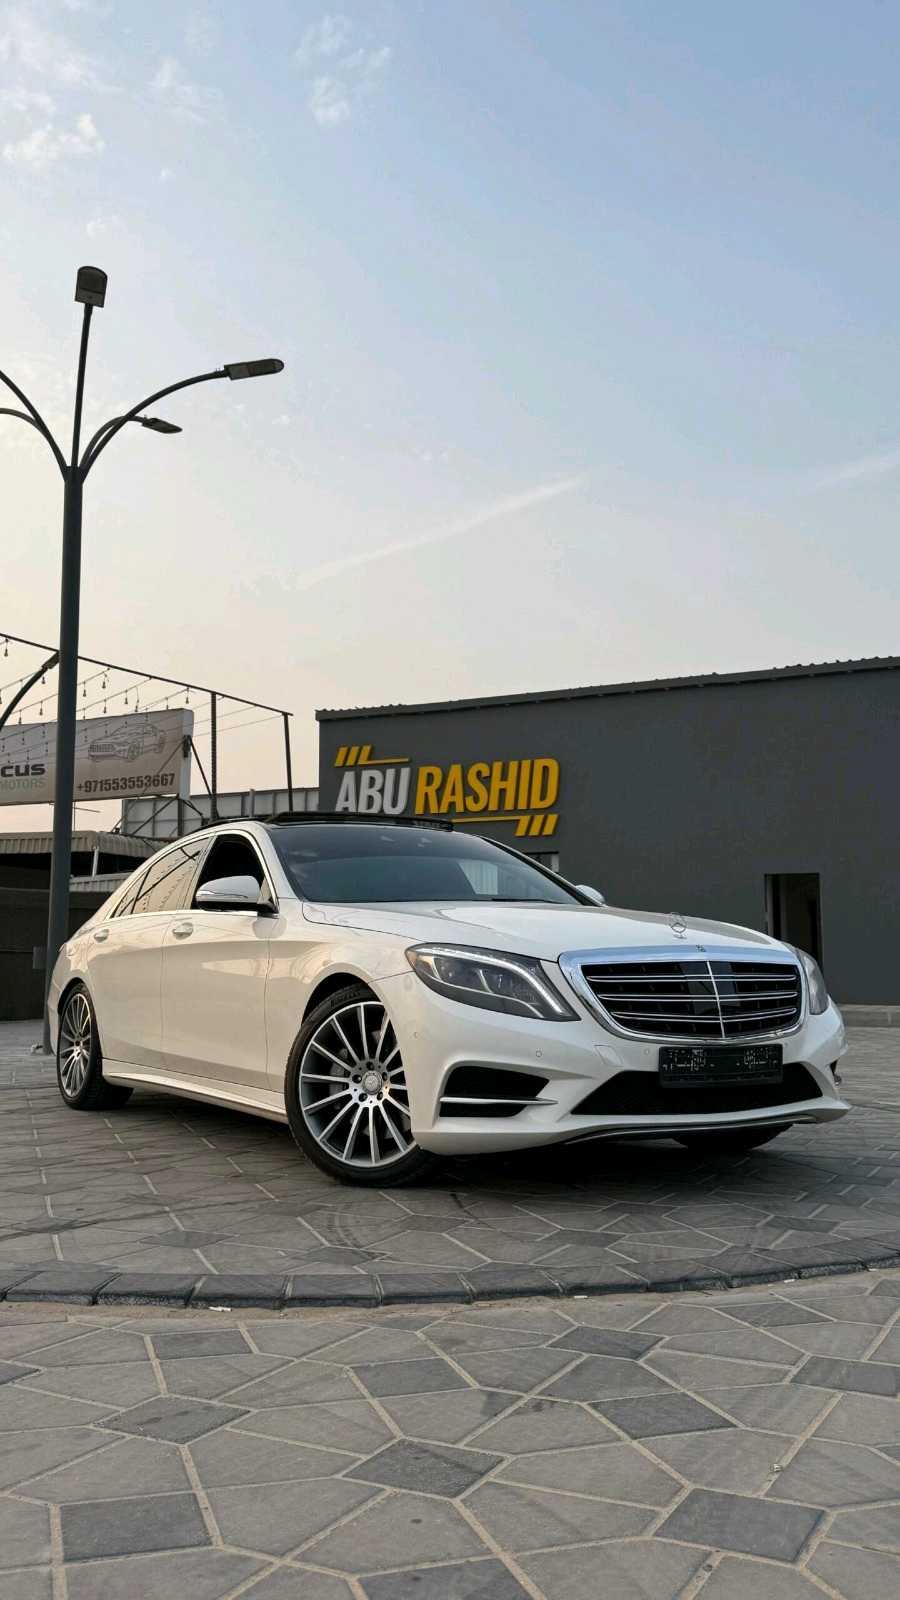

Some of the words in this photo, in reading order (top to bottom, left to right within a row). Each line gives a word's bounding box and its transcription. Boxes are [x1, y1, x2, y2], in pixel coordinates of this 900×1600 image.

[77, 773, 175, 793] +971553553667
[335, 767, 411, 815] ABU
[415, 758, 560, 815] RASHID
